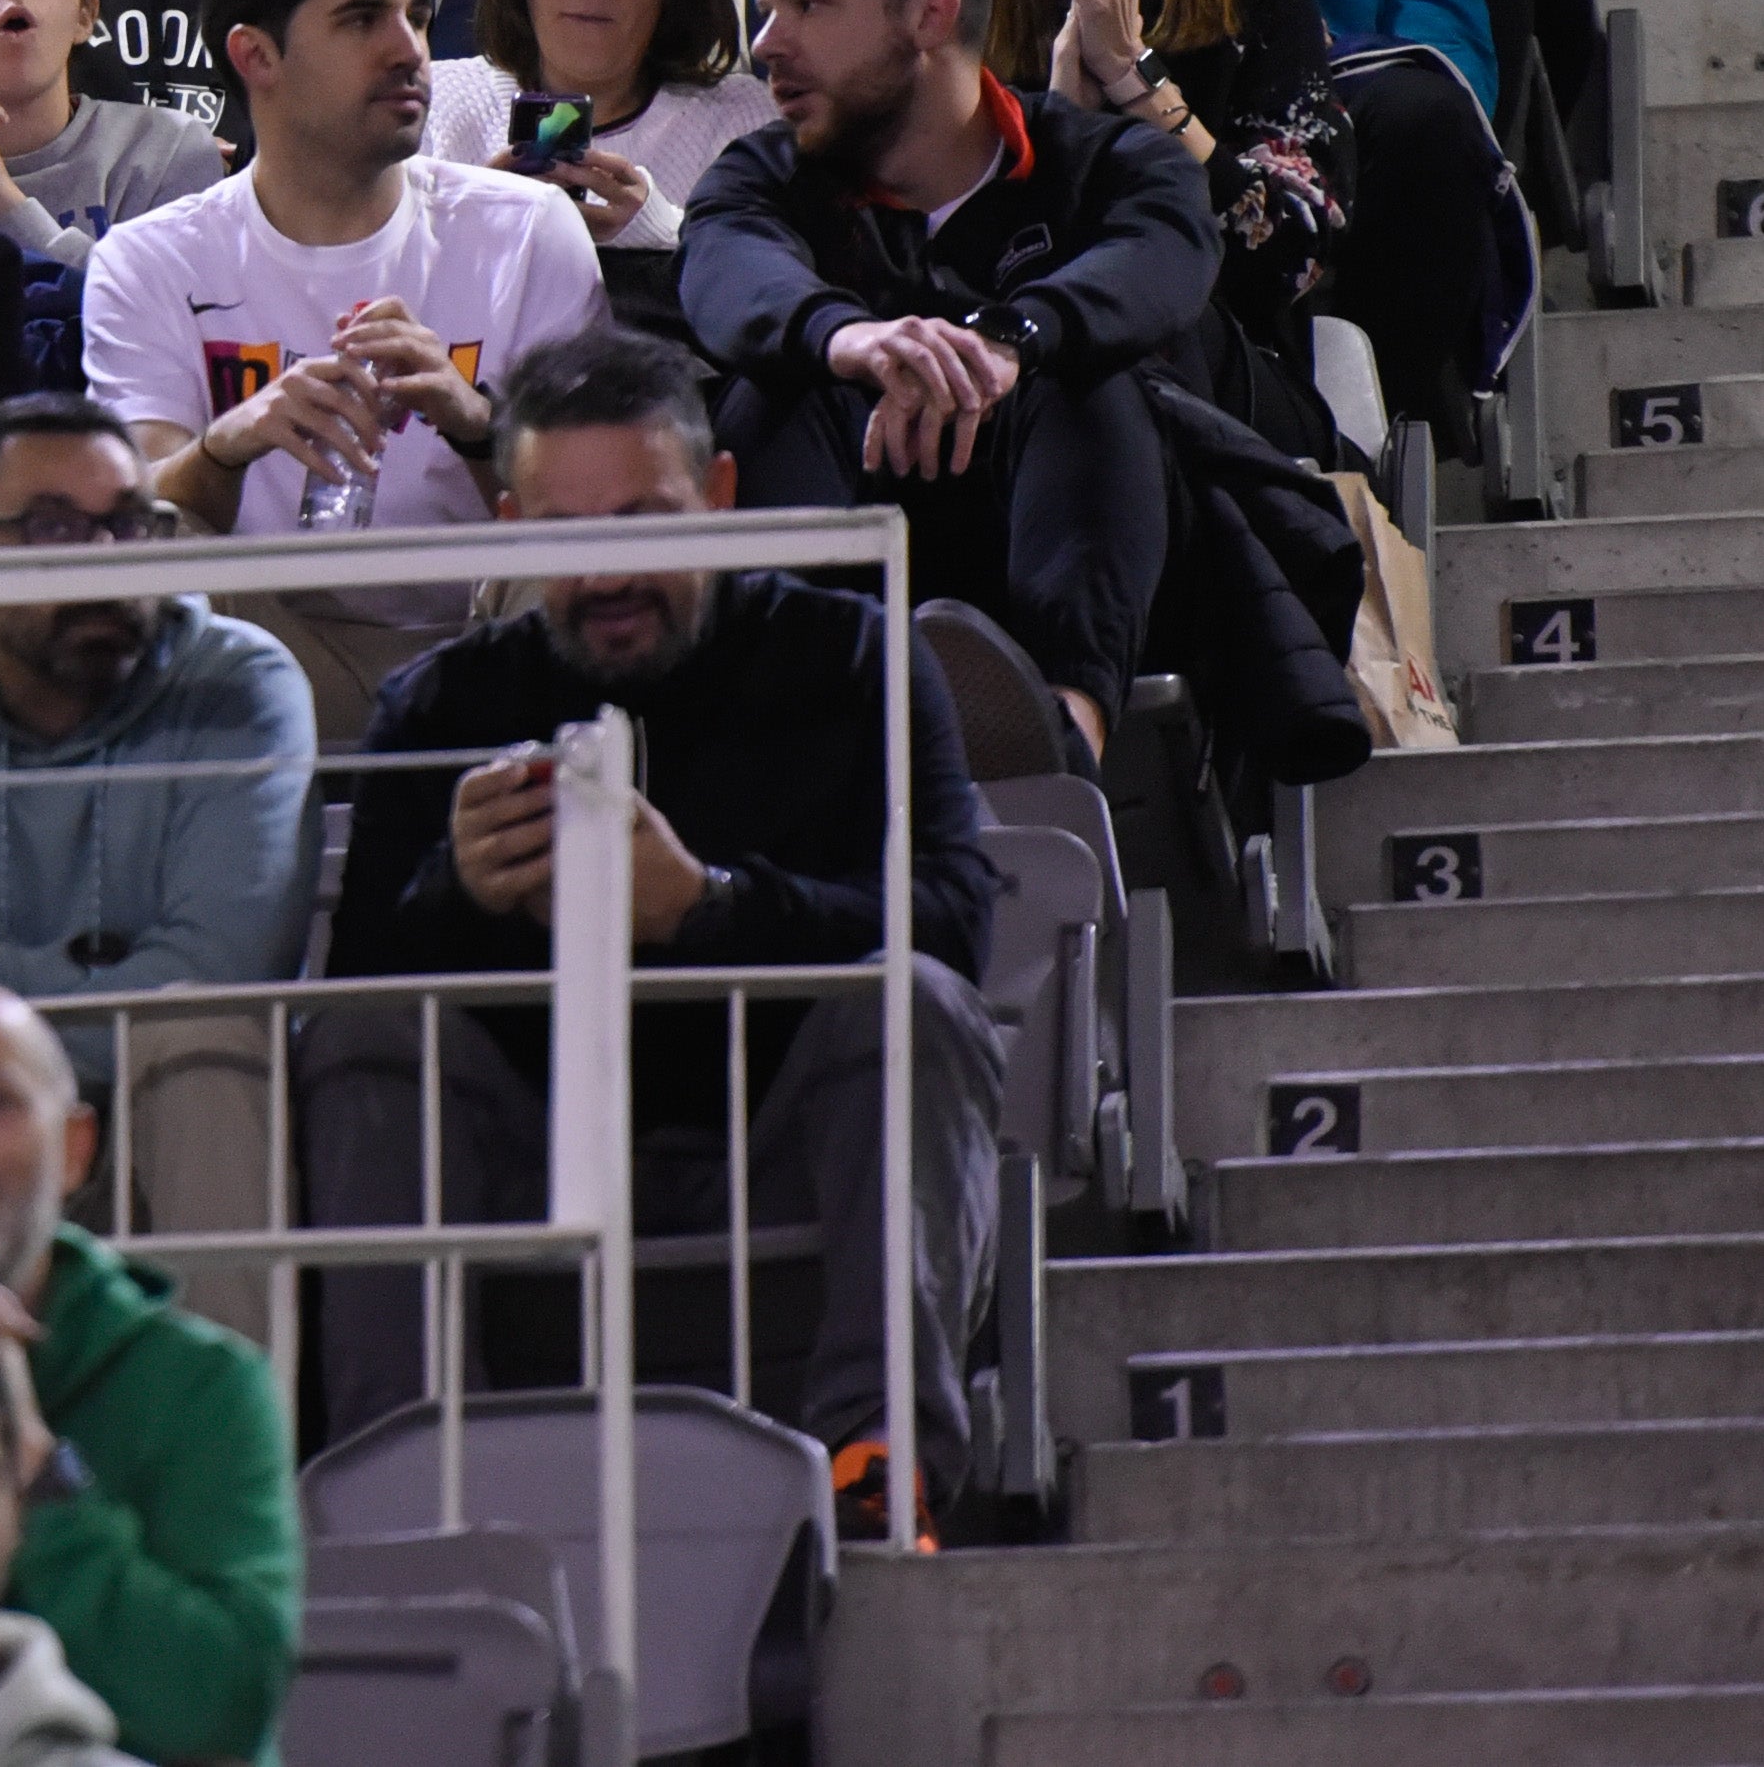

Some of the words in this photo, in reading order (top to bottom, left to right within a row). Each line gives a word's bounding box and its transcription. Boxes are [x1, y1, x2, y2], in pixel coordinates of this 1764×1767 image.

[1640, 397, 1684, 448] 5
[1533, 609, 1580, 664] 4
[1415, 846, 1461, 905] 3
[1292, 1096, 1337, 1156] 2
[1160, 1378, 1190, 1437] 1
